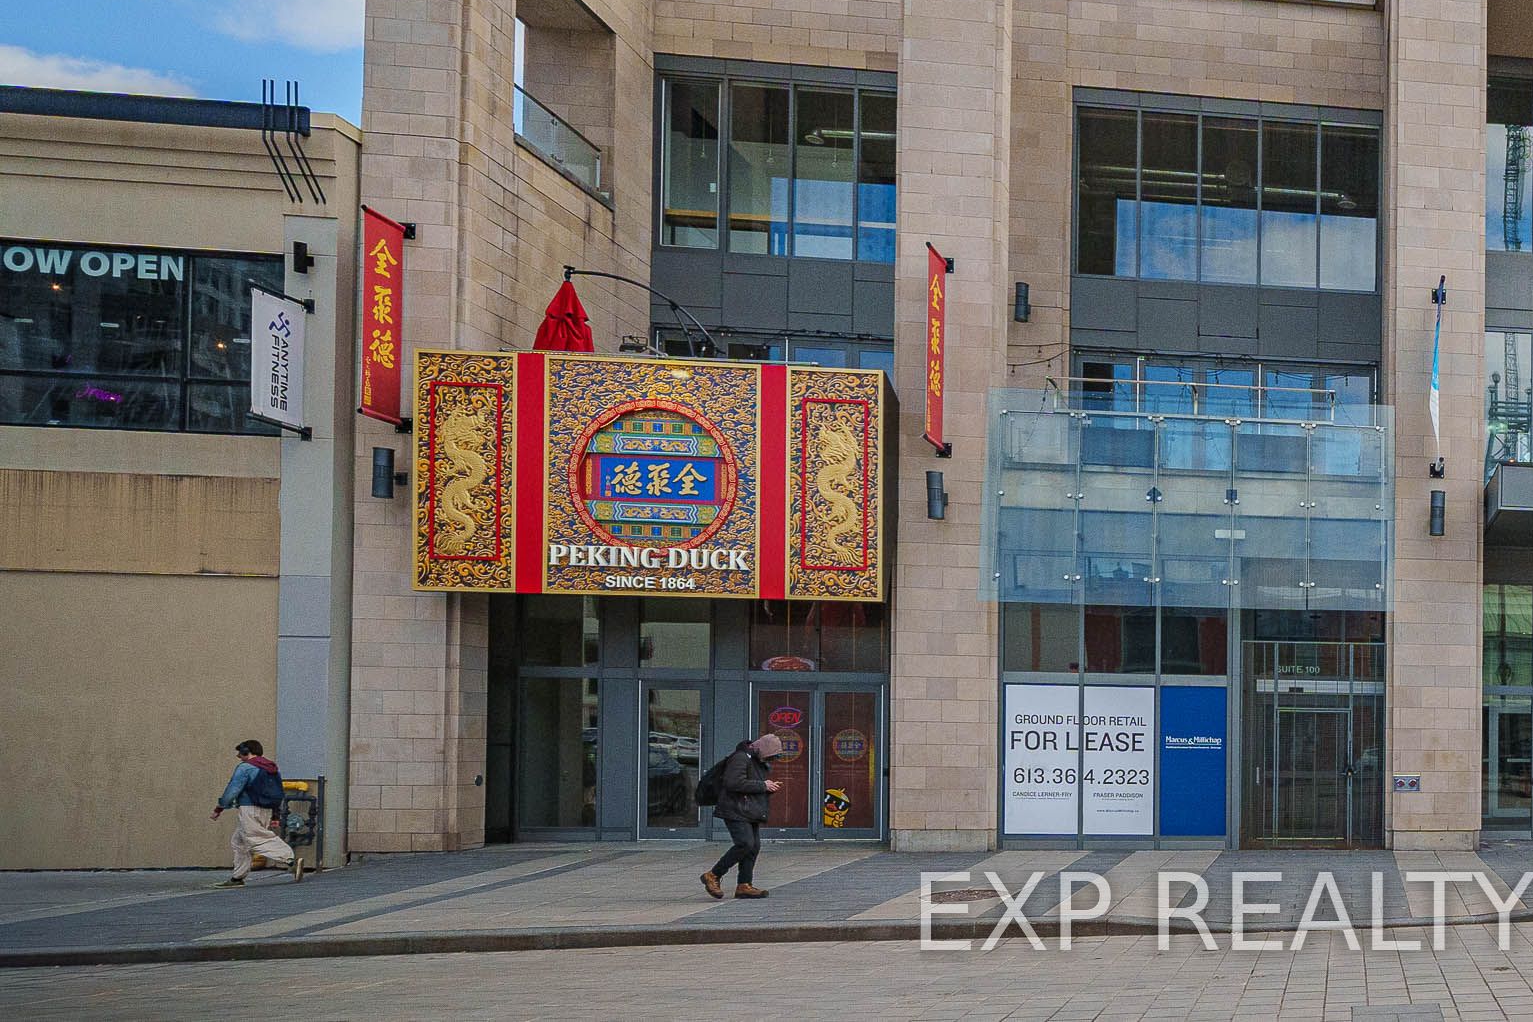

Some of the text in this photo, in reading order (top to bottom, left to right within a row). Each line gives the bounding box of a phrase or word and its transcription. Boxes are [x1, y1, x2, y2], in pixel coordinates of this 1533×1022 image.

[2, 245, 185, 281] OW OPEN
[270, 333, 281, 409] FITNESS
[279, 337, 289, 412] ANYTIME
[549, 544, 752, 571] PEKING DUCK
[605, 575, 697, 590] SINCE 1864
[1277, 665, 1321, 674] SUITE 100
[770, 710, 801, 725] OPEN
[1014, 714, 1147, 727] GROUND FLOOR RETAIL
[1010, 730, 1145, 752] FOR LEASE
[1165, 735, 1188, 744] Marcus
[1194, 736, 1222, 745] Millichap
[1013, 767, 1150, 786] 613.364.2323
